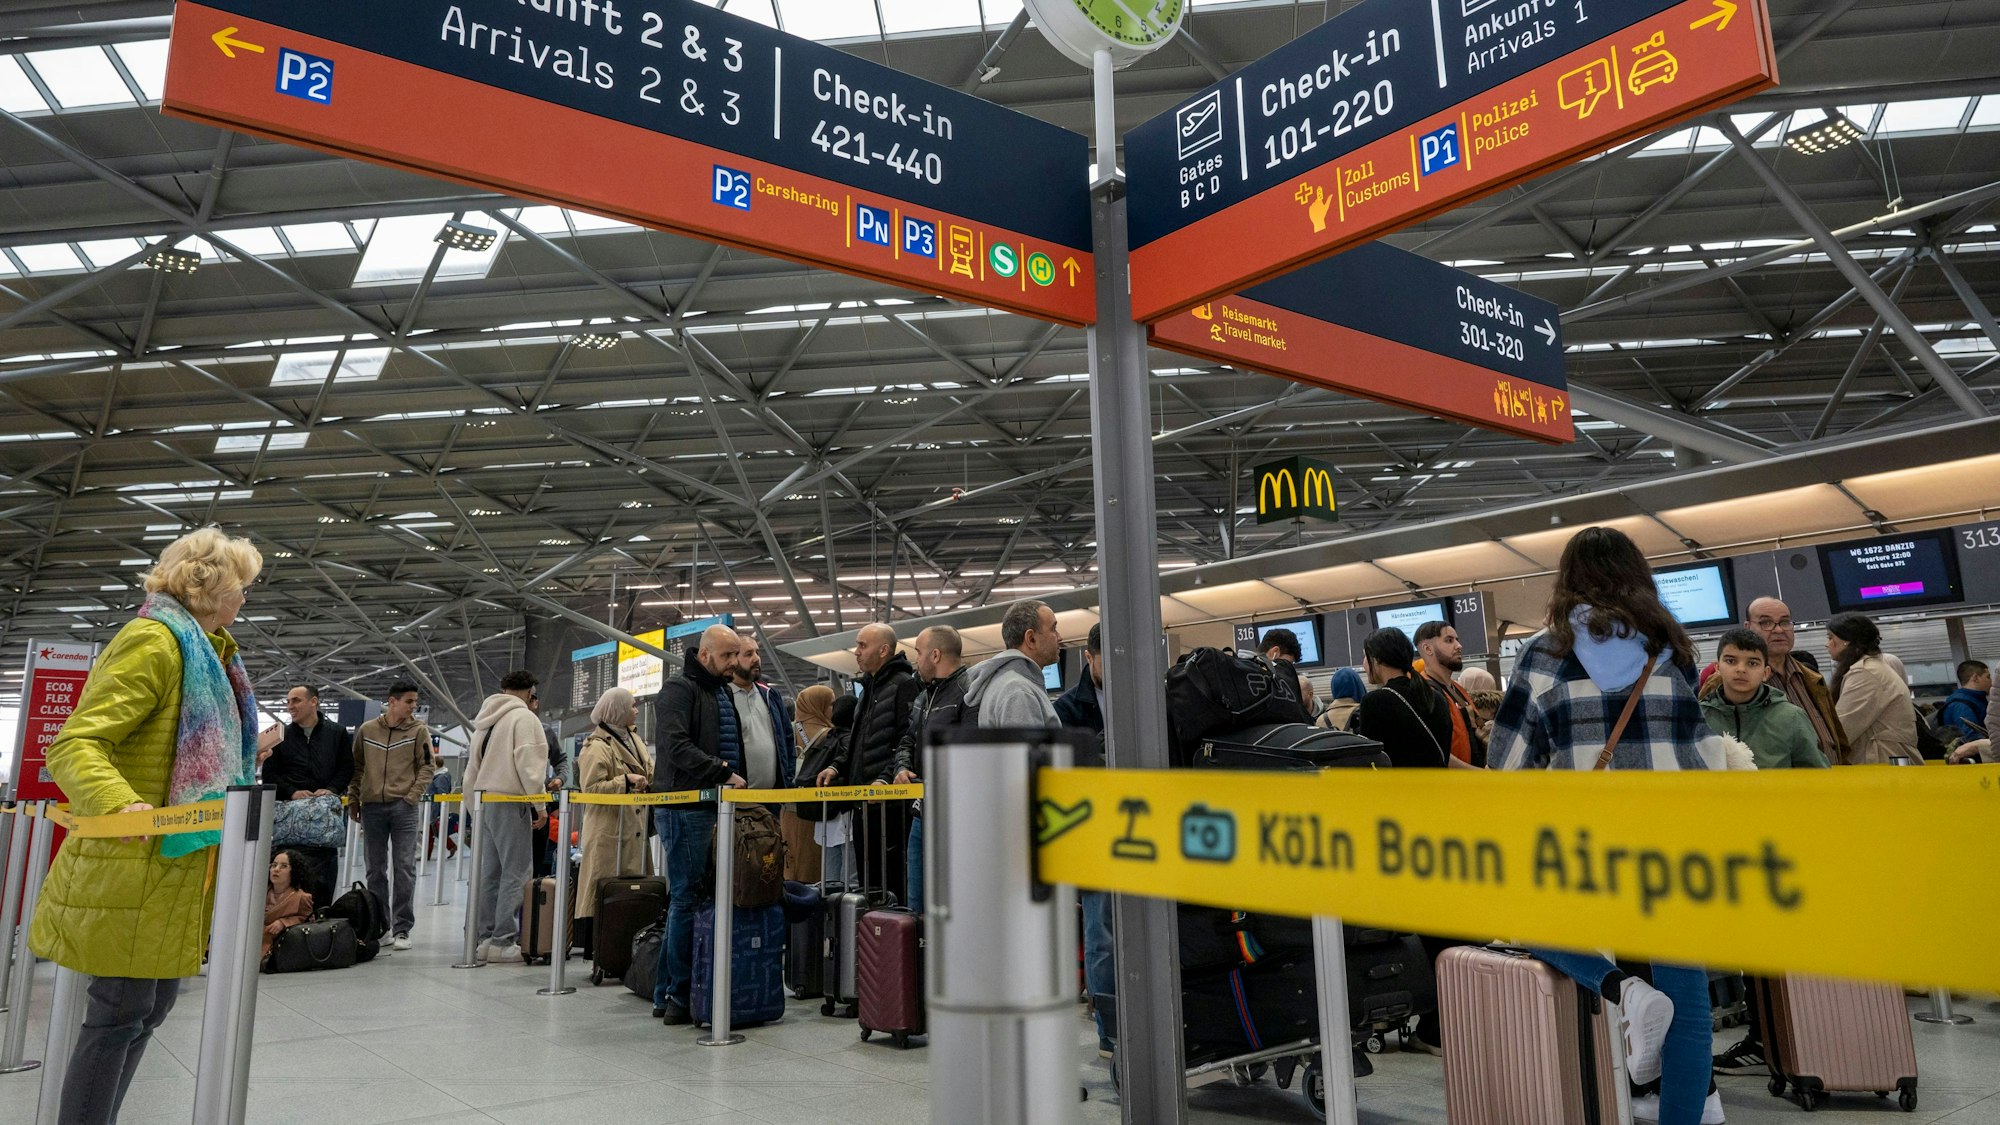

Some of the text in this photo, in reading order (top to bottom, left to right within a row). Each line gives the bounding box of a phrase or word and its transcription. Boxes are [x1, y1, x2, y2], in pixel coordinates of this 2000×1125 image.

[641, 12, 663, 49] 2
[681, 25, 707, 62] &
[722, 37, 743, 72] 3
[1468, 0, 1588, 75] Arrivals 1
[441, 5, 741, 126] Arrivals 2 & 3
[1261, 28, 1401, 117] Check-in
[813, 68, 953, 140] Check-in
[1472, 89, 1539, 131] Polizei
[1264, 79, 1394, 169] 101-220
[1474, 122, 1529, 155] Police
[811, 119, 942, 185] 421-440
[1179, 154, 1223, 185] Gates
[1344, 160, 1375, 186] Zoll
[756, 177, 839, 216] Carsharing
[1181, 175, 1220, 208] B C D
[1346, 171, 1411, 208] Customs
[1222, 305, 1278, 332] Reisemarkt
[1456, 285, 1525, 328] Check-in
[1223, 322, 1287, 351] Travel market
[1460, 321, 1524, 361] 301-320
[1497, 380, 1508, 392] WC
[1519, 390, 1529, 401] WC
[1885, 542, 1915, 552] DANZIG
[1962, 527, 2000, 550] 313
[1857, 555, 1890, 564] Departure
[1454, 597, 1478, 614] 315
[1237, 627, 1255, 641] 316
[45, 682, 73, 692] ECO&
[45, 694, 71, 704] FLEX
[40, 705, 72, 715] CLASS
[43, 723, 64, 732] BAG
[1257, 810, 1804, 917] Köln Bonn Airport
